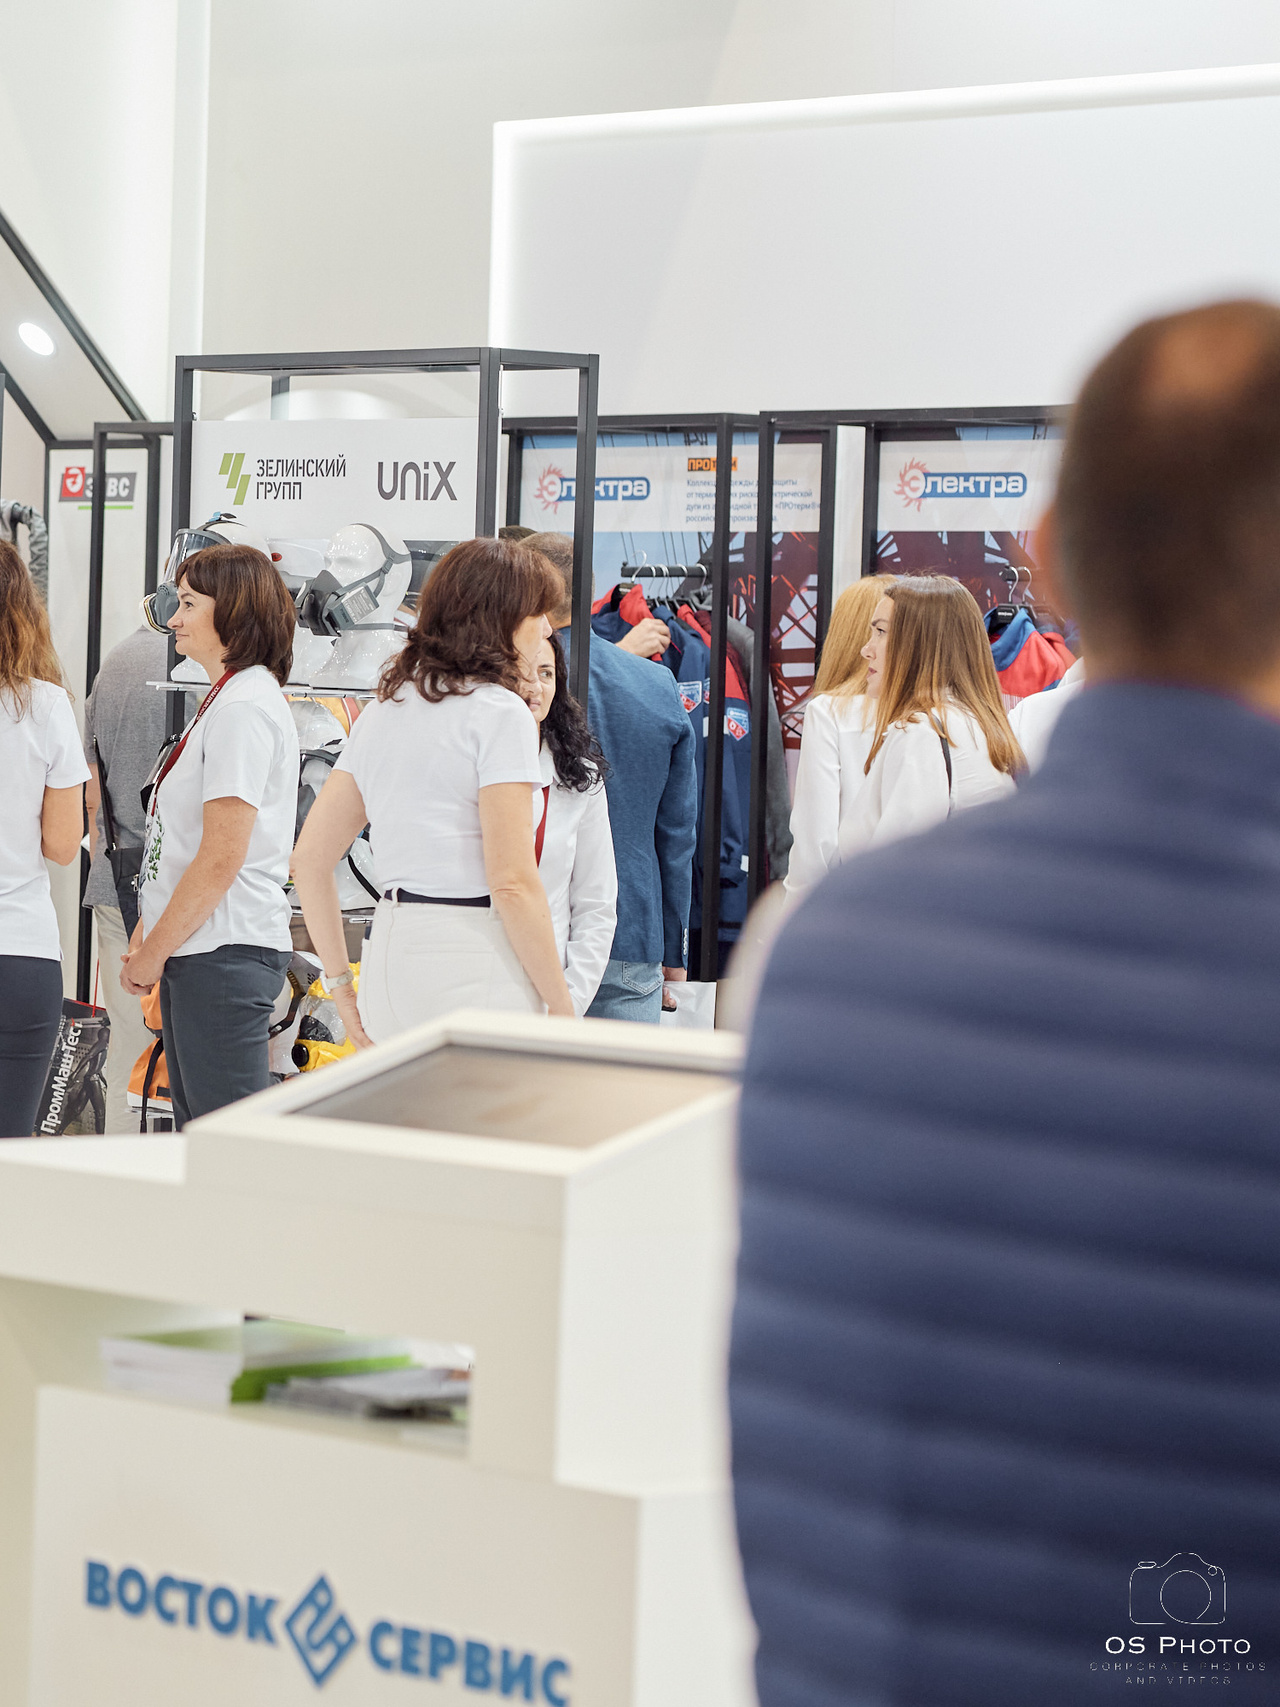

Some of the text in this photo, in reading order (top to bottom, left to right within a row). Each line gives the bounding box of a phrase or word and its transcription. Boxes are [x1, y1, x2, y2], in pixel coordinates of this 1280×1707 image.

[256, 454, 346, 477] ЗЕЛИНСКИЙ
[256, 482, 302, 500] ГРУПП
[541, 474, 649, 502] Элктра
[903, 468, 1024, 499] Электра
[40, 1018, 83, 1134] ПромМашТест
[86, 1560, 570, 1707] ВОСТОК СЕРВИС
